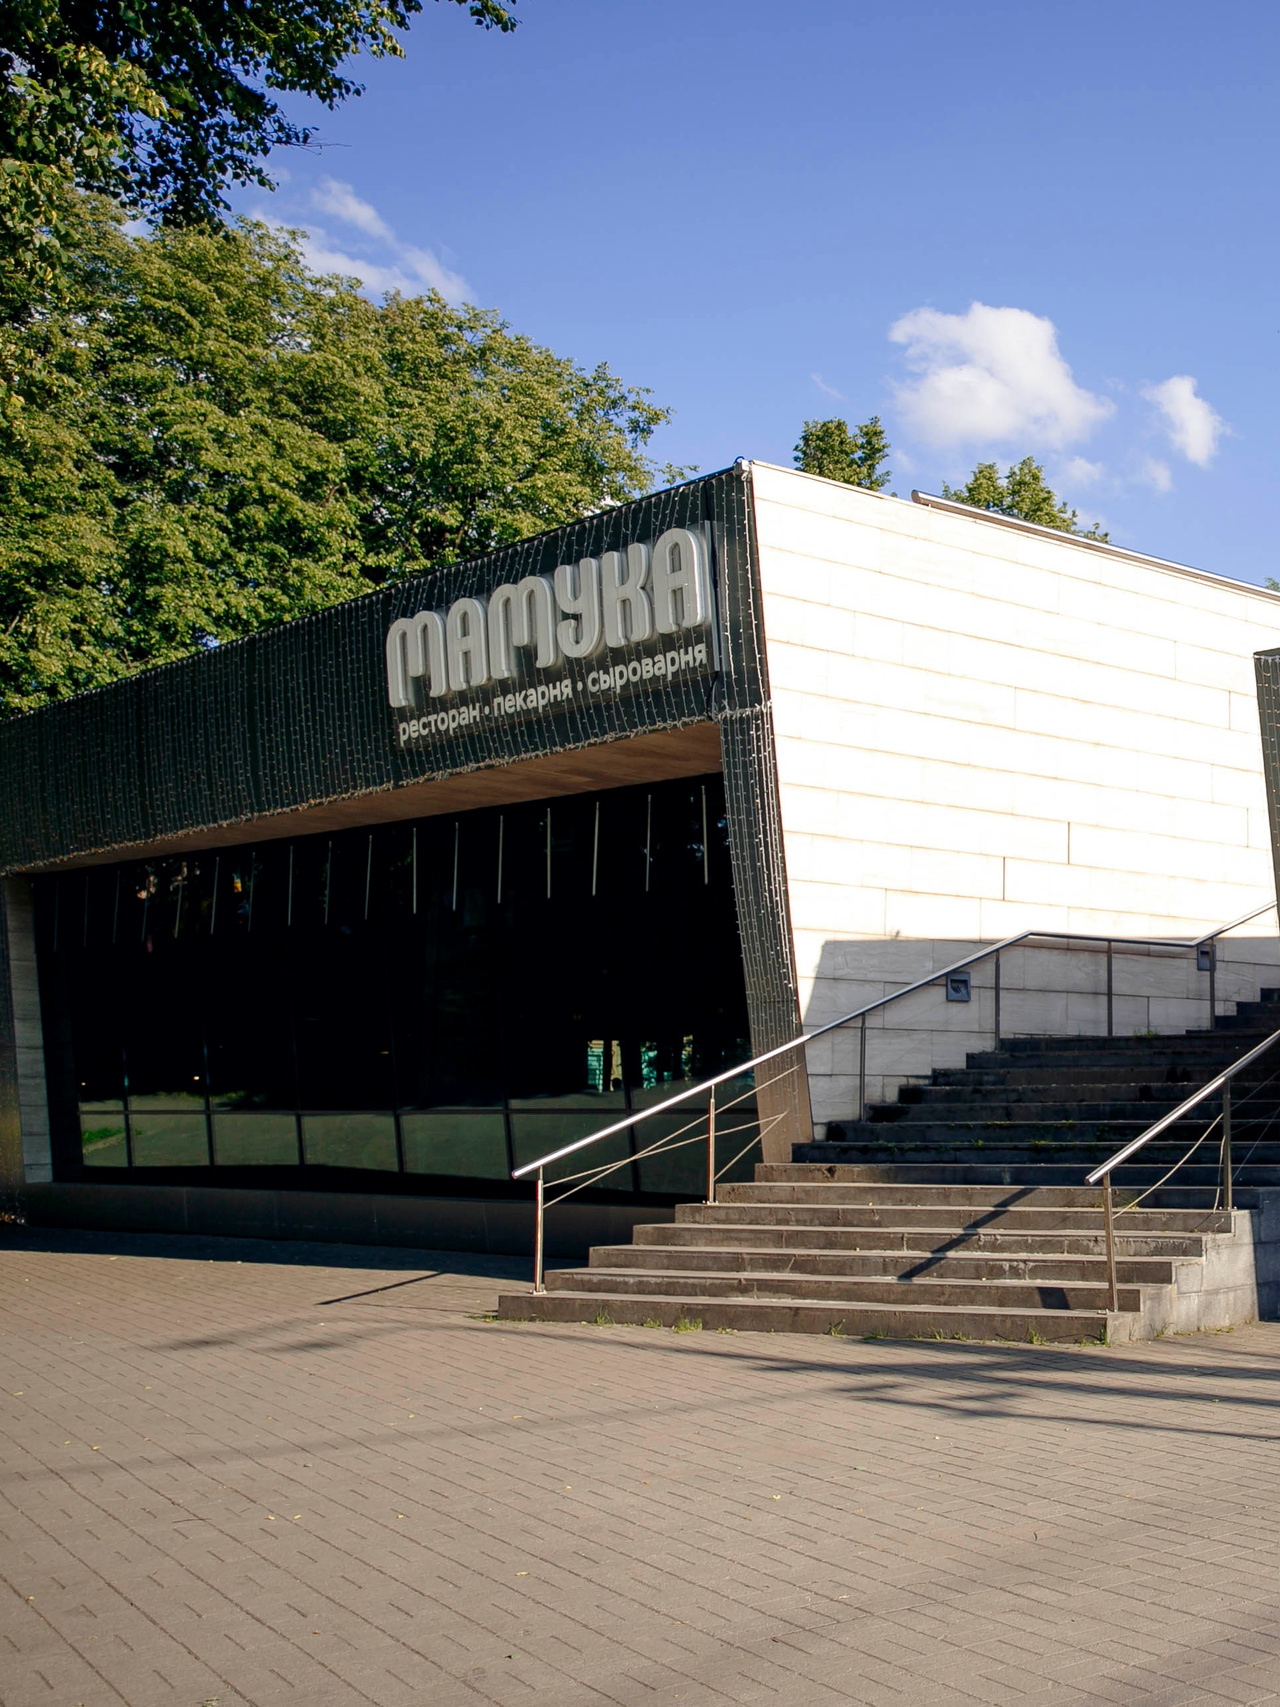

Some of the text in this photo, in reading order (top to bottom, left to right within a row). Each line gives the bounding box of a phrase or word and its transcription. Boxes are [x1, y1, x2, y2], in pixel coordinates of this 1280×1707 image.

[386, 528, 707, 708] МАМУКА
[399, 643, 707, 746] ресторан пекарня сыроварня
